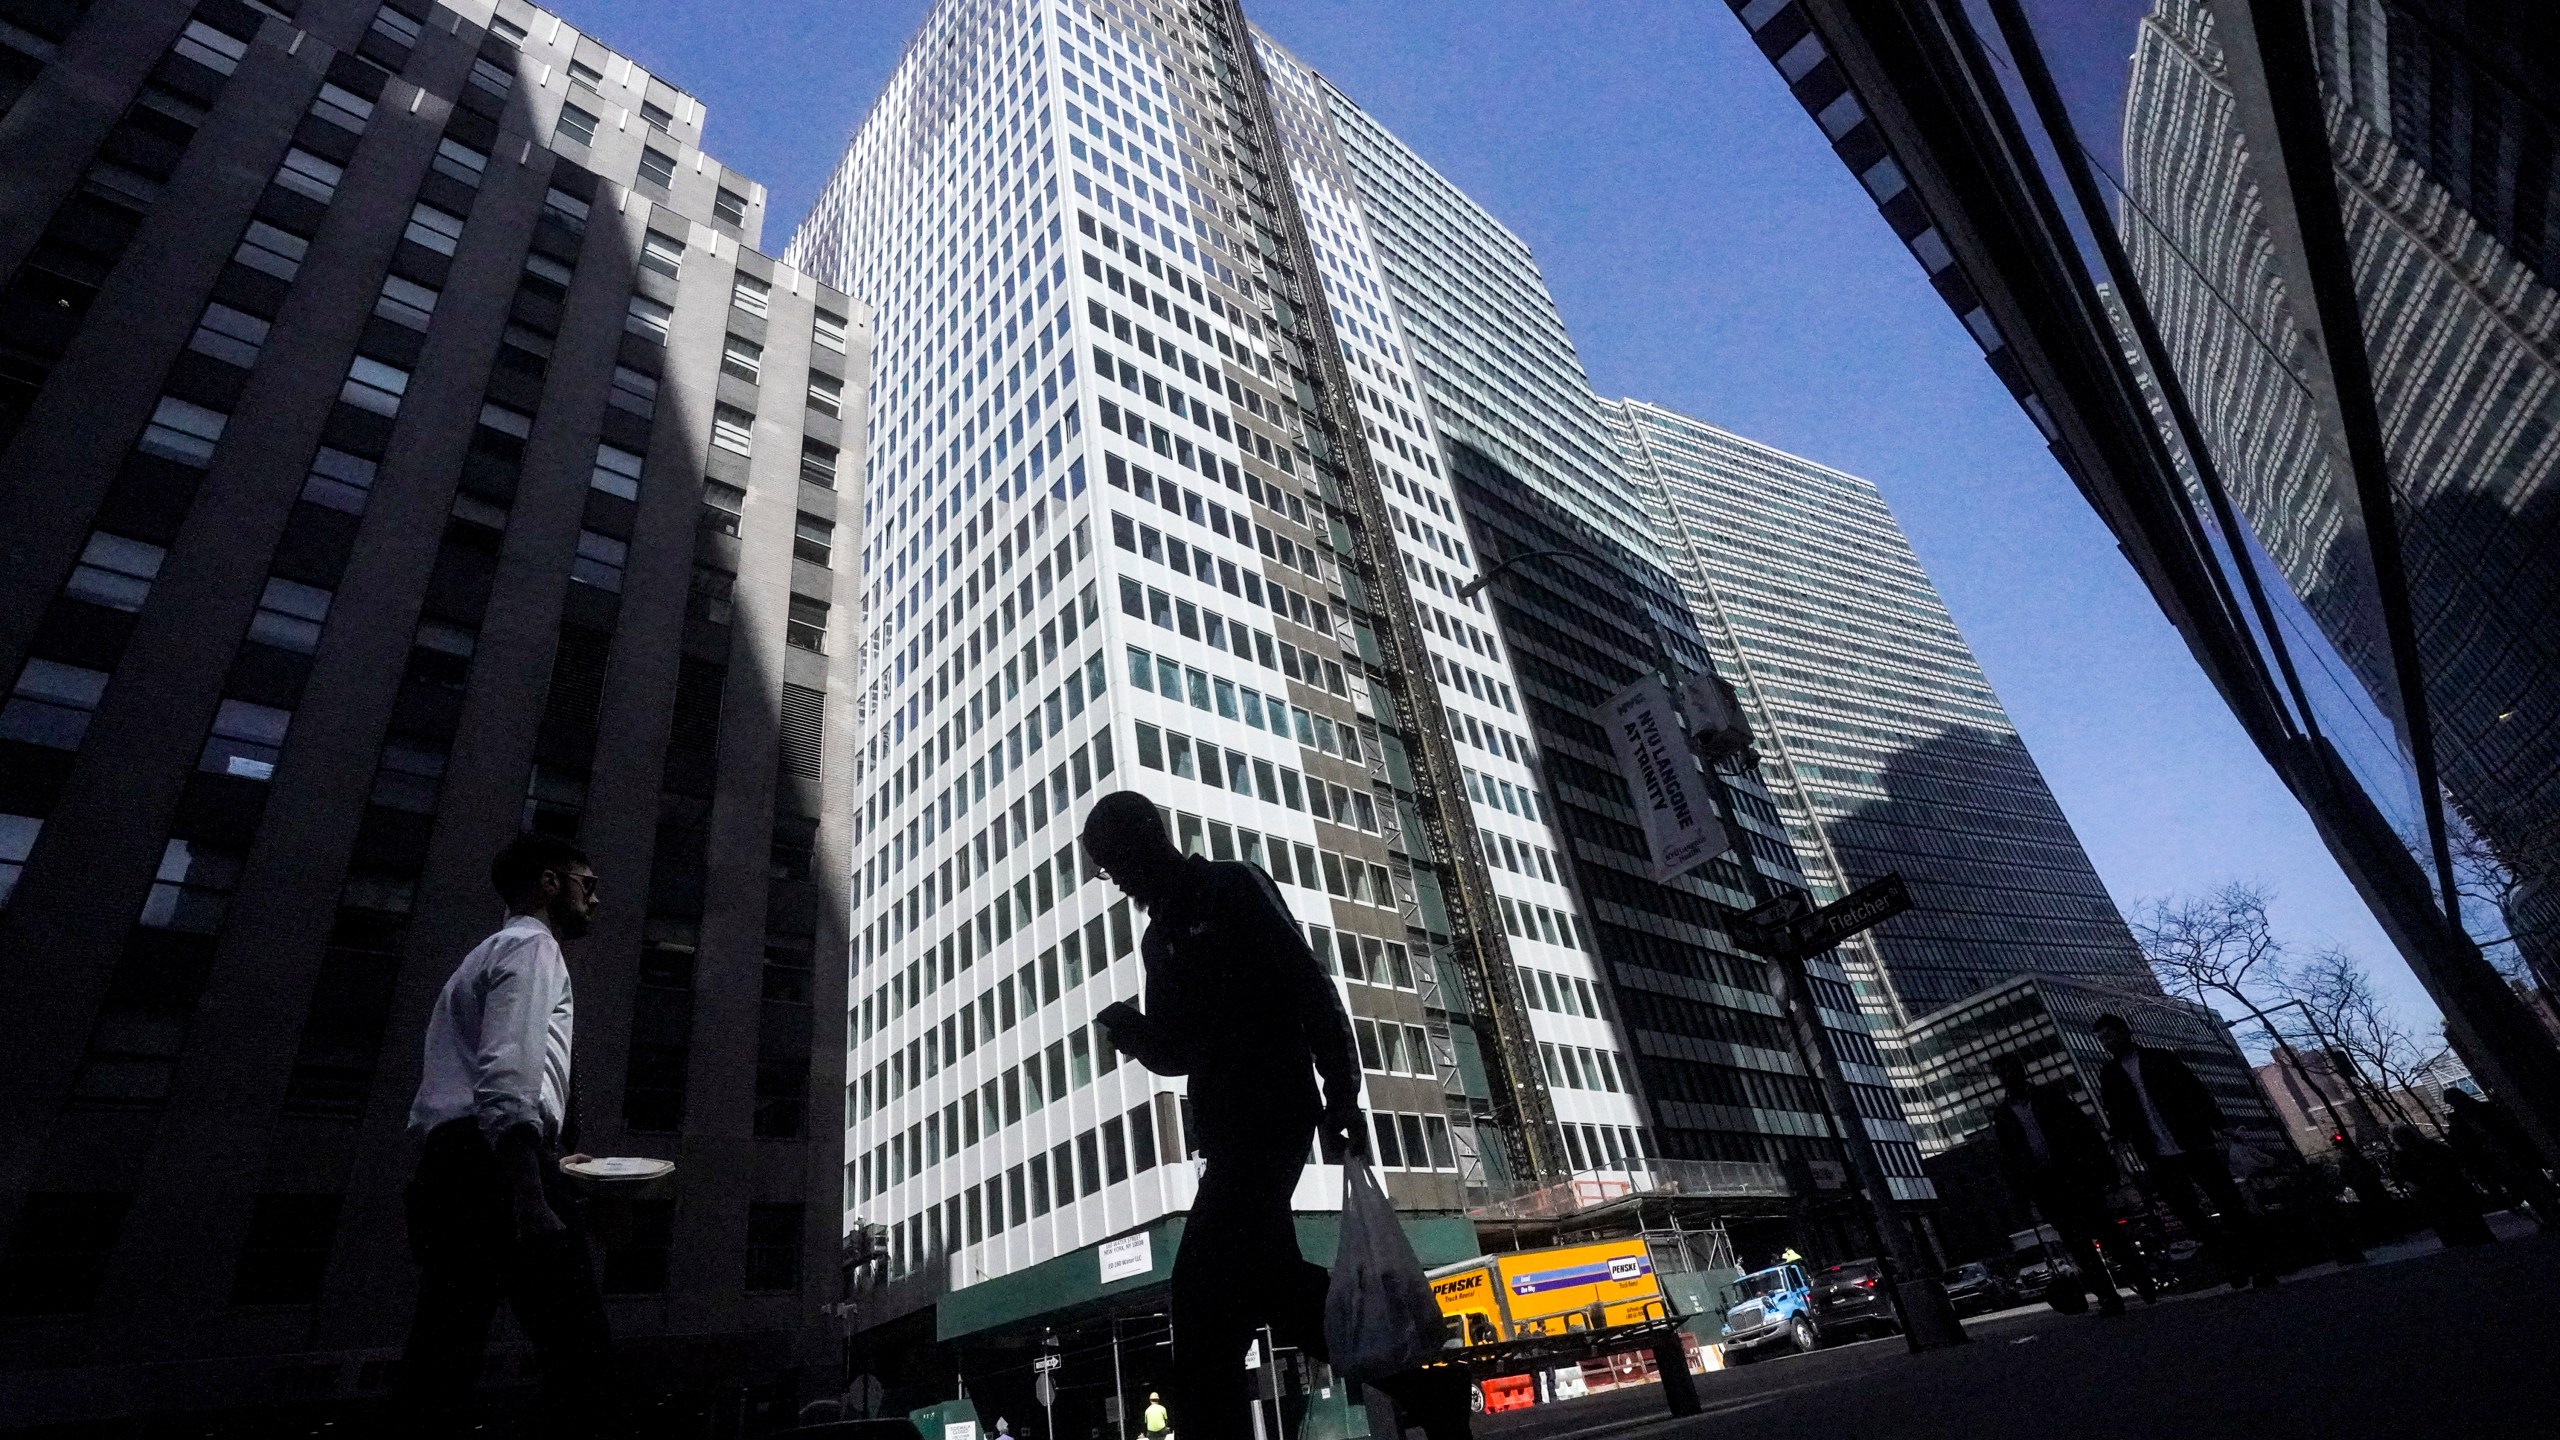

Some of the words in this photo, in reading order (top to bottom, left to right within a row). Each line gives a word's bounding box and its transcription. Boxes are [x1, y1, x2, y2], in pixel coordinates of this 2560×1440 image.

[1624, 722, 1641, 743] AT
[1634, 743, 1668, 812] TRINITY
[1637, 710, 1662, 748] NYU
[1652, 747, 1694, 831] LANGONE
[1828, 895, 1890, 933] Fletcher
[1612, 1262, 1637, 1274] PENSKE
[1433, 1275, 1483, 1295] PENSKE
[1459, 1290, 1475, 1299] Rental
